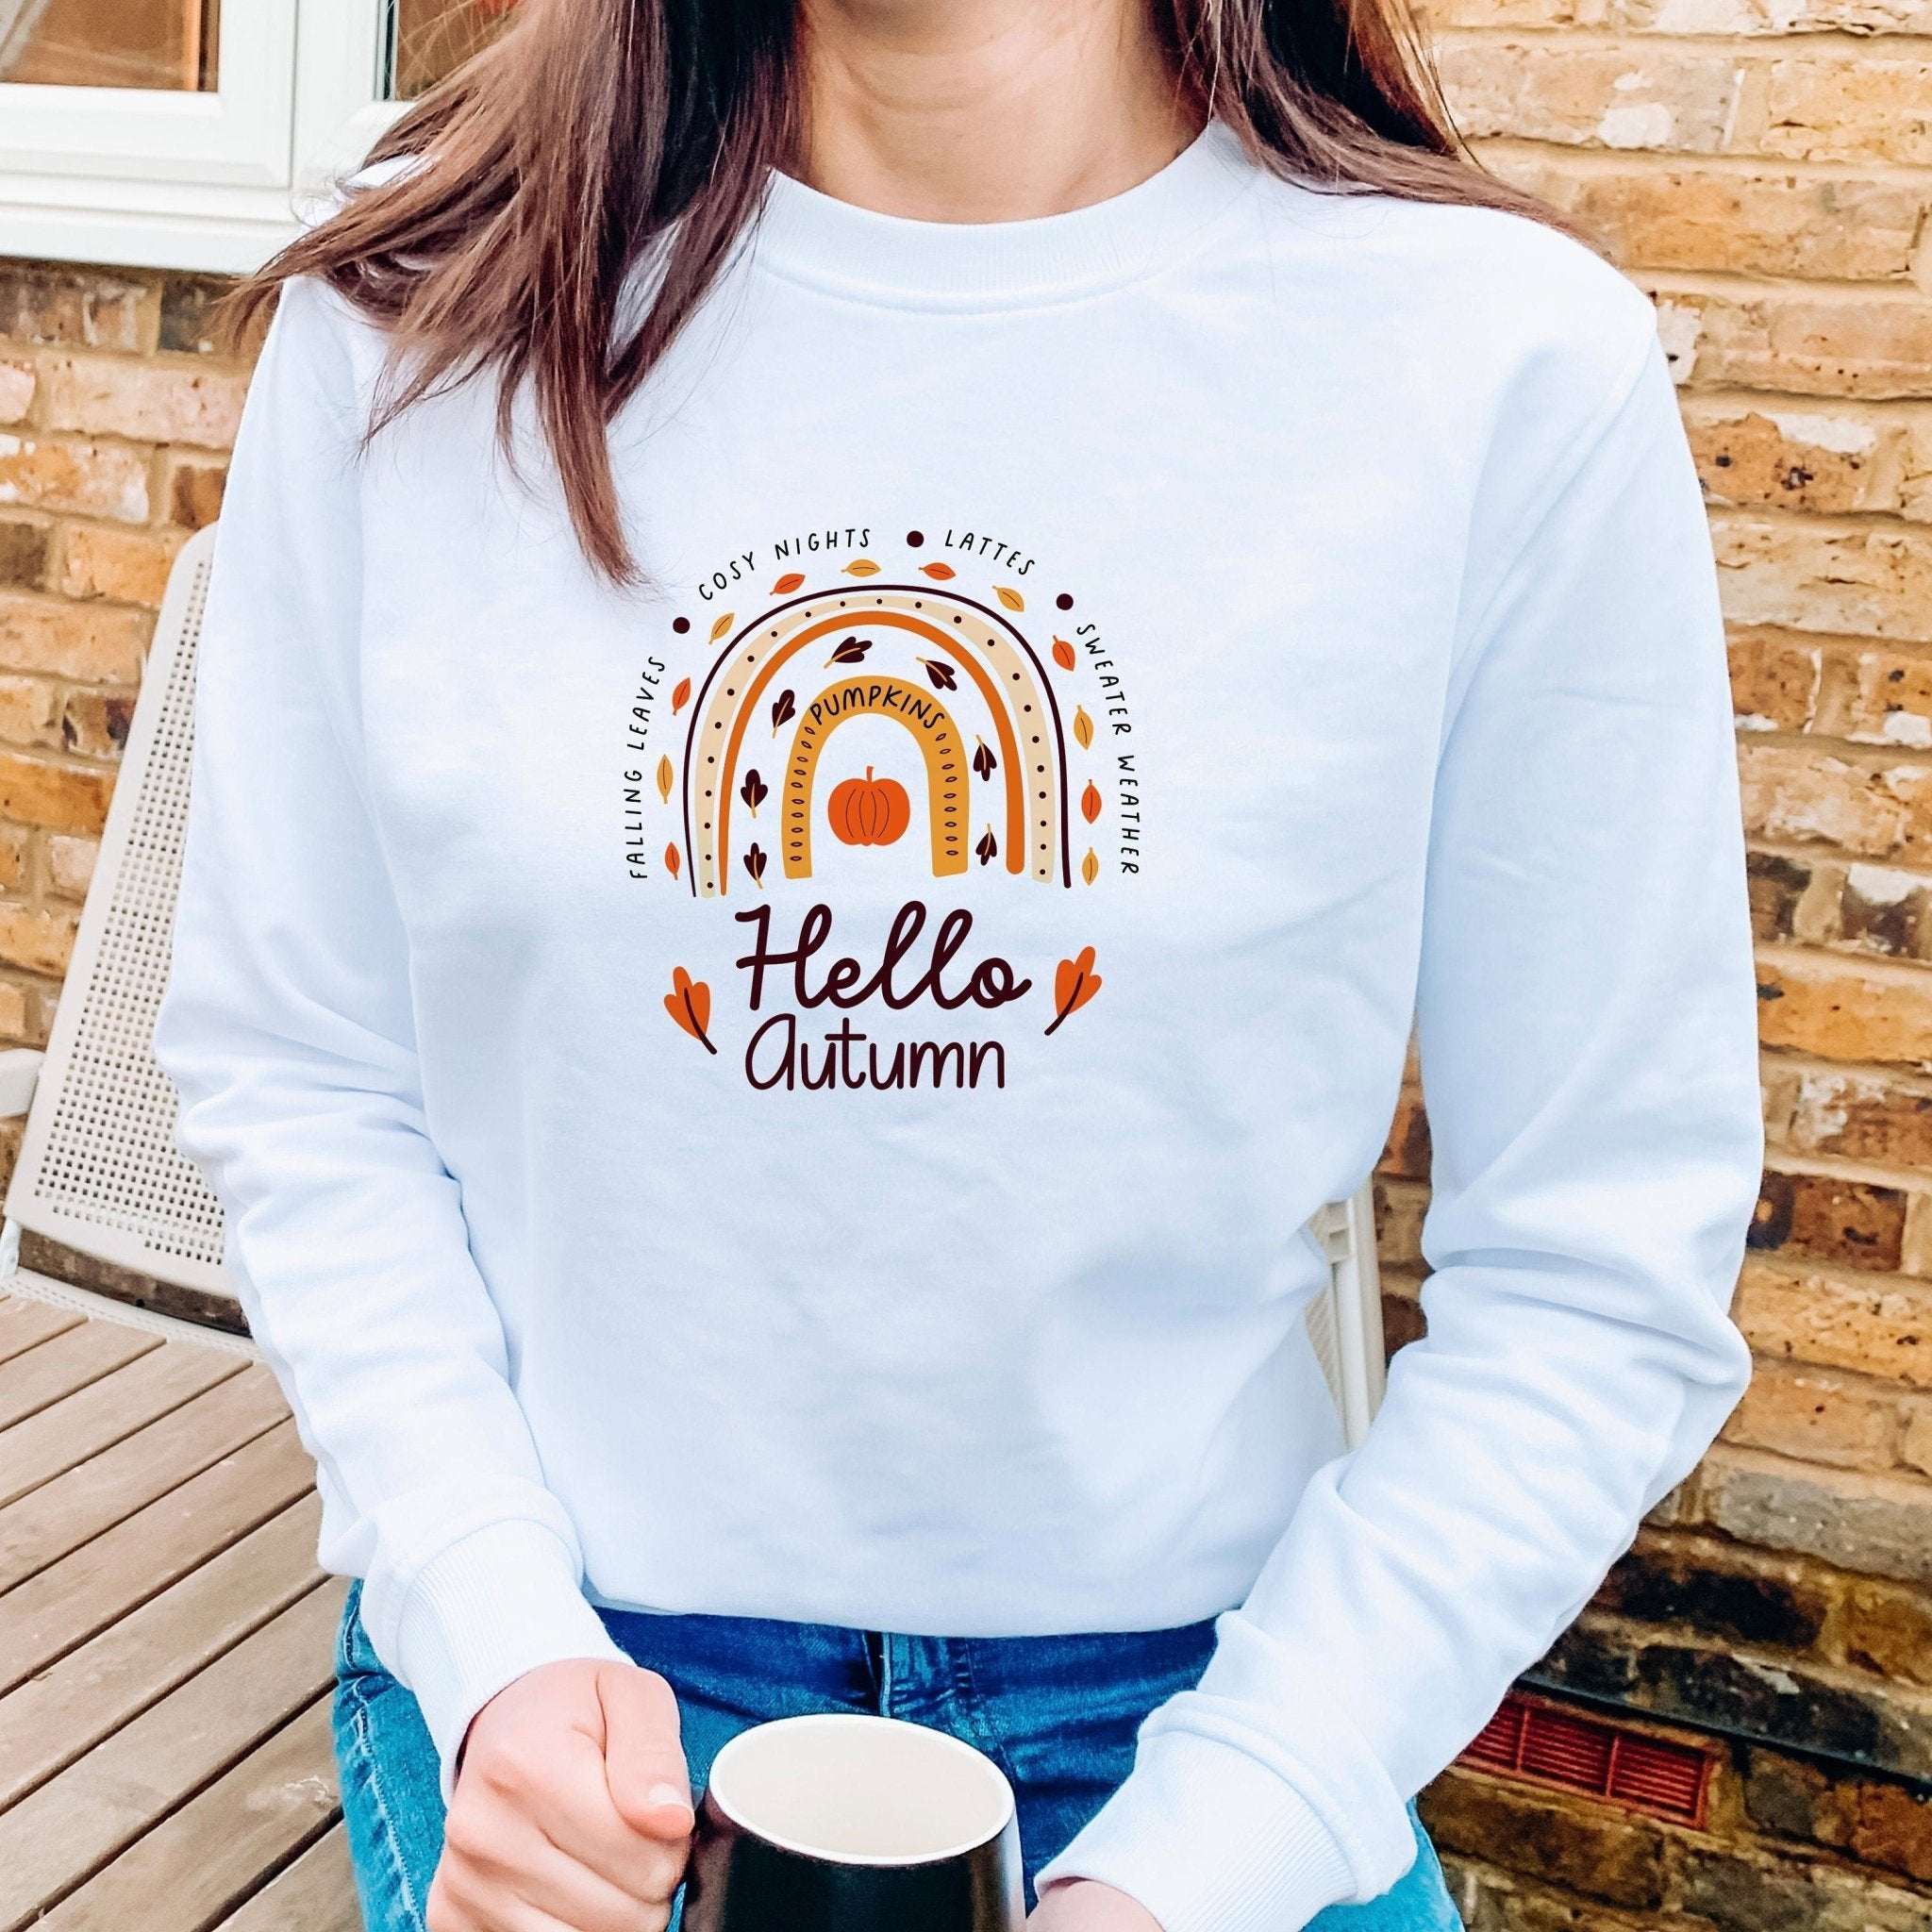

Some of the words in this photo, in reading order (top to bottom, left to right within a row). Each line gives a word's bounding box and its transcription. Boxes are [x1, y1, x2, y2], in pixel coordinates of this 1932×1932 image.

[698, 551, 755, 601] COSY
[774, 528, 871, 560] NIGHTS
[944, 529, 1036, 575] LATTES
[626, 656, 666, 751] LEAVES
[808, 684, 945, 729] PUMPKINS
[1076, 624, 1132, 736] SWEATER
[623, 770, 648, 879] FALLING
[1117, 755, 1141, 874] WEATHER
[734, 900, 1033, 1011] Hello
[744, 1012, 1006, 1091] Autumn
